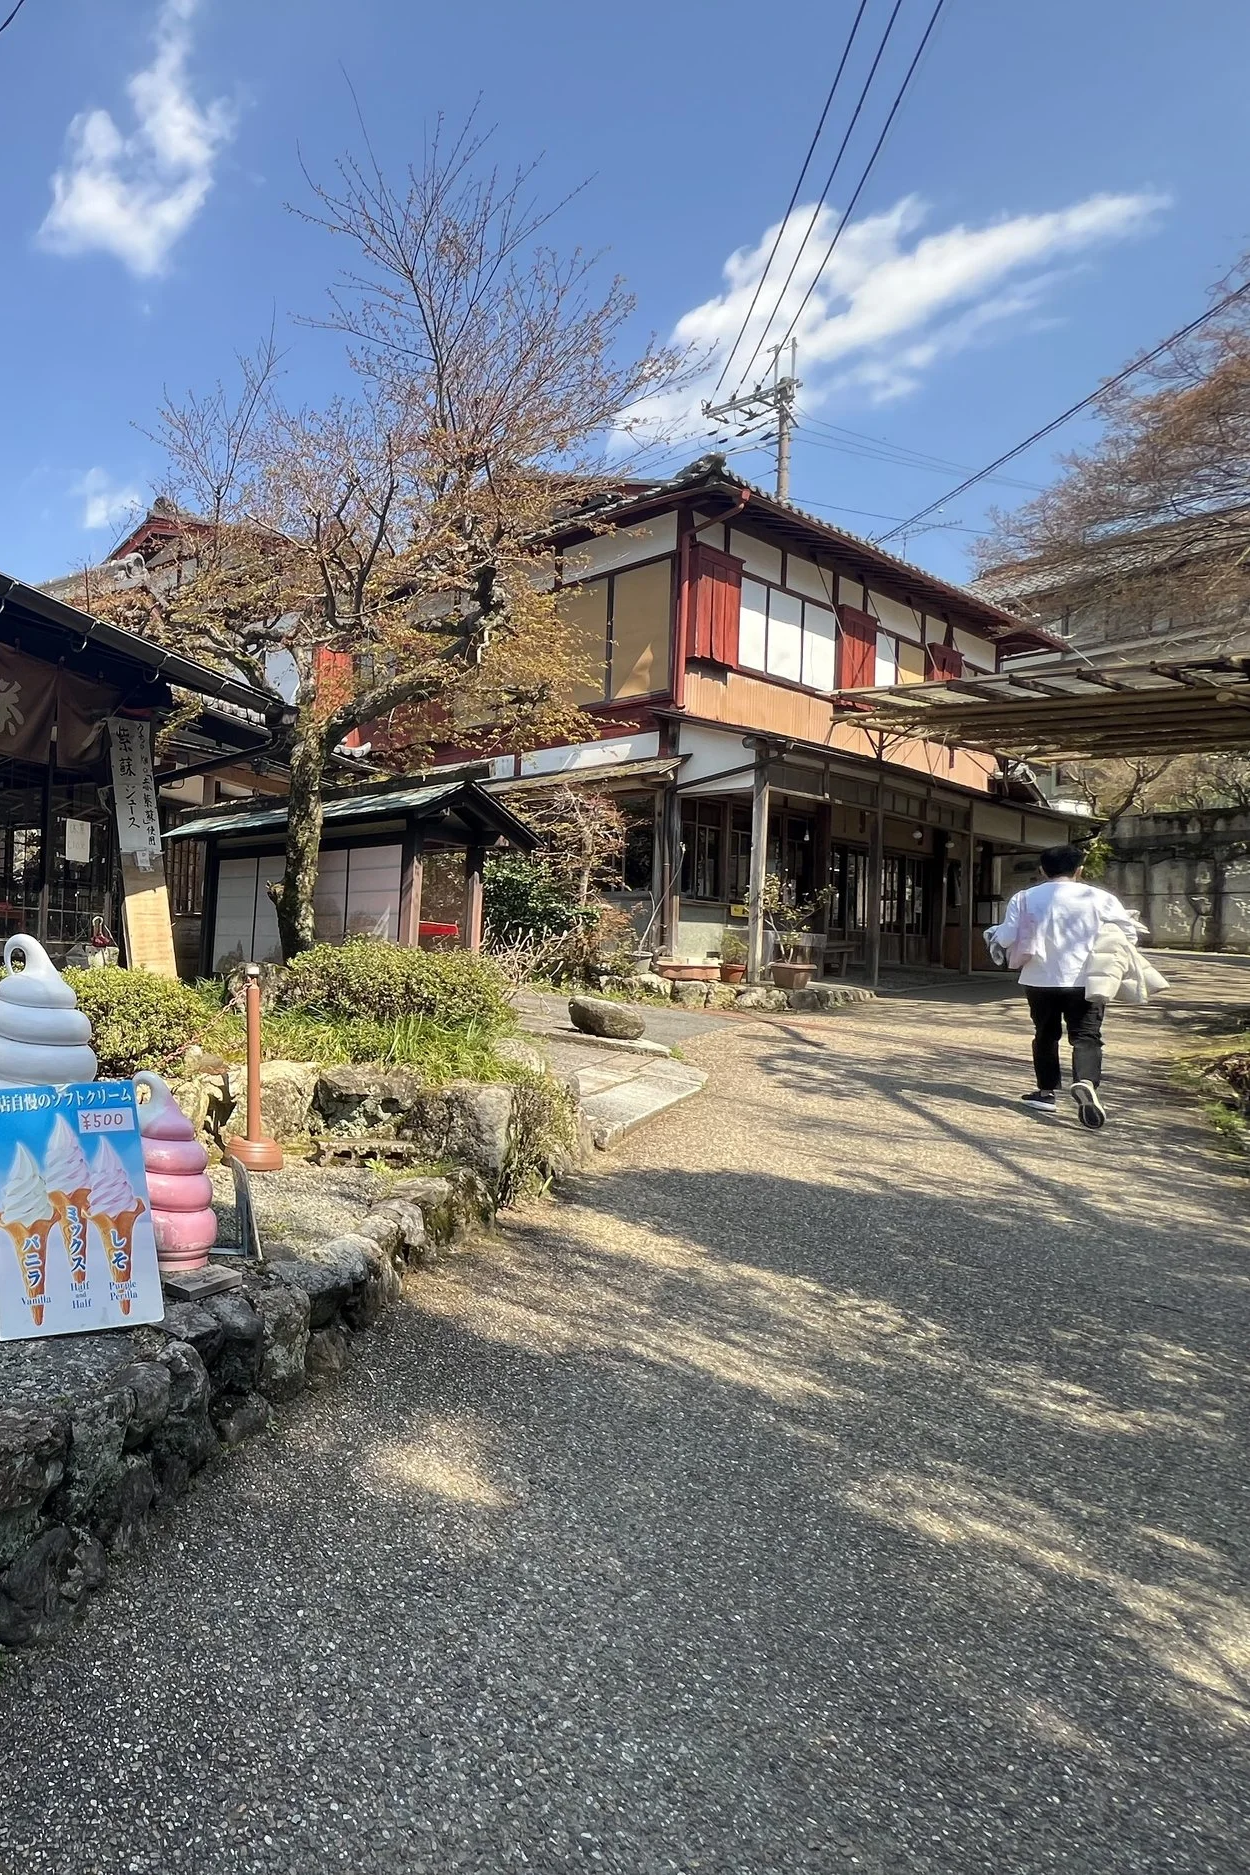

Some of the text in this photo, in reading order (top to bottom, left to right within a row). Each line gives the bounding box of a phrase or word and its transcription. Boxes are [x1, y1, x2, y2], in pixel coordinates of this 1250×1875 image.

[116, 726, 141, 829] 紫蘇ジュース
[81, 1112, 123, 1130] ¥500
[66, 1206, 86, 1272] ミックス
[111, 1230, 128, 1270] しそ
[23, 1235, 41, 1287] バニラ
[21, 1294, 52, 1306] Vanilla
[70, 1281, 91, 1291] Half
[72, 1299, 92, 1309] Half
